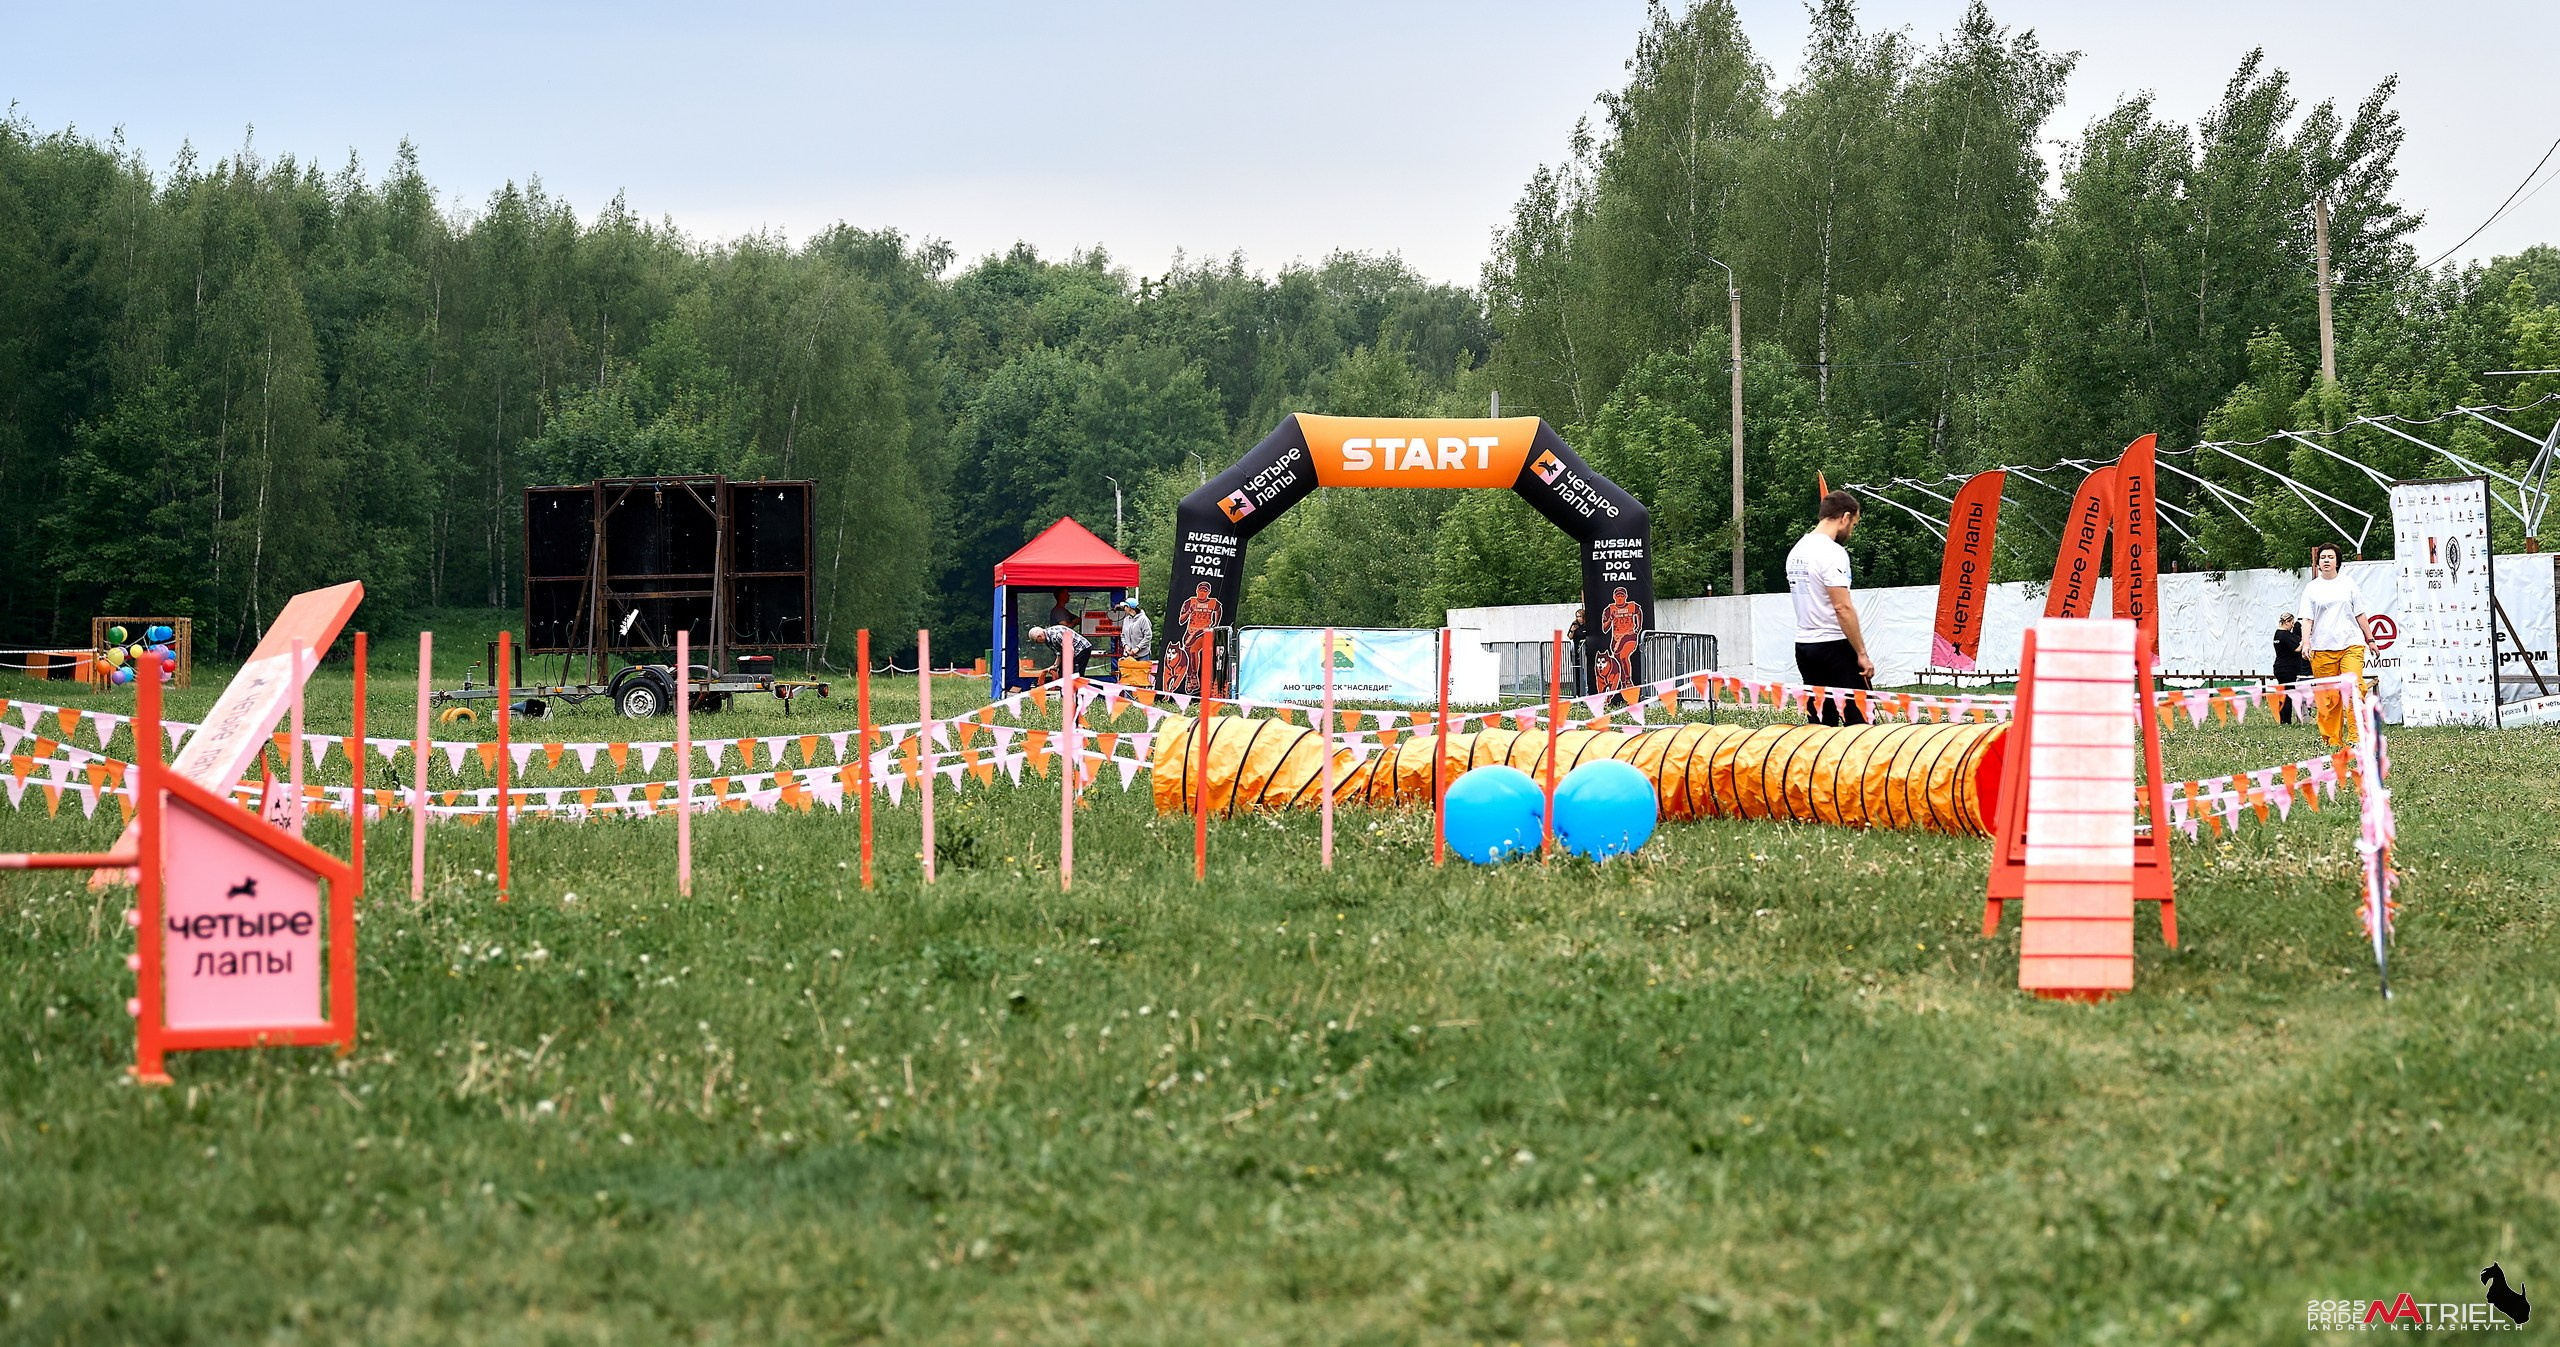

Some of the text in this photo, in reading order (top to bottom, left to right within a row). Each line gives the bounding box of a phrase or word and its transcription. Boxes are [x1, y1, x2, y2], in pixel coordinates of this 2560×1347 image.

[1342, 436, 1499, 471] START
[1243, 447, 1301, 492] четыре
[777, 492, 785, 501] 4
[1255, 470, 1297, 506] лапы
[1566, 470, 1620, 518] четыре
[1553, 482, 1596, 518] лапы
[2128, 475, 2141, 536] лапы
[1187, 531, 1238, 546] RUSSIAN
[1594, 538, 1642, 549] RUSSIAN
[1184, 543, 1237, 557] EXTREME
[1194, 555, 1222, 566] DOG
[1592, 549, 1644, 560] EXTREME
[2061, 496, 2101, 618] етыре лапы
[1190, 565, 1225, 578] TRAIL
[1602, 571, 1637, 582] TRAIL
[1605, 561, 1631, 571] DOG
[1953, 502, 1984, 635] четыре лапы
[1344, 684, 1393, 692] "НАСЛЕДИЕ"
[168, 908, 314, 939] четыре
[193, 948, 293, 977] лапы
